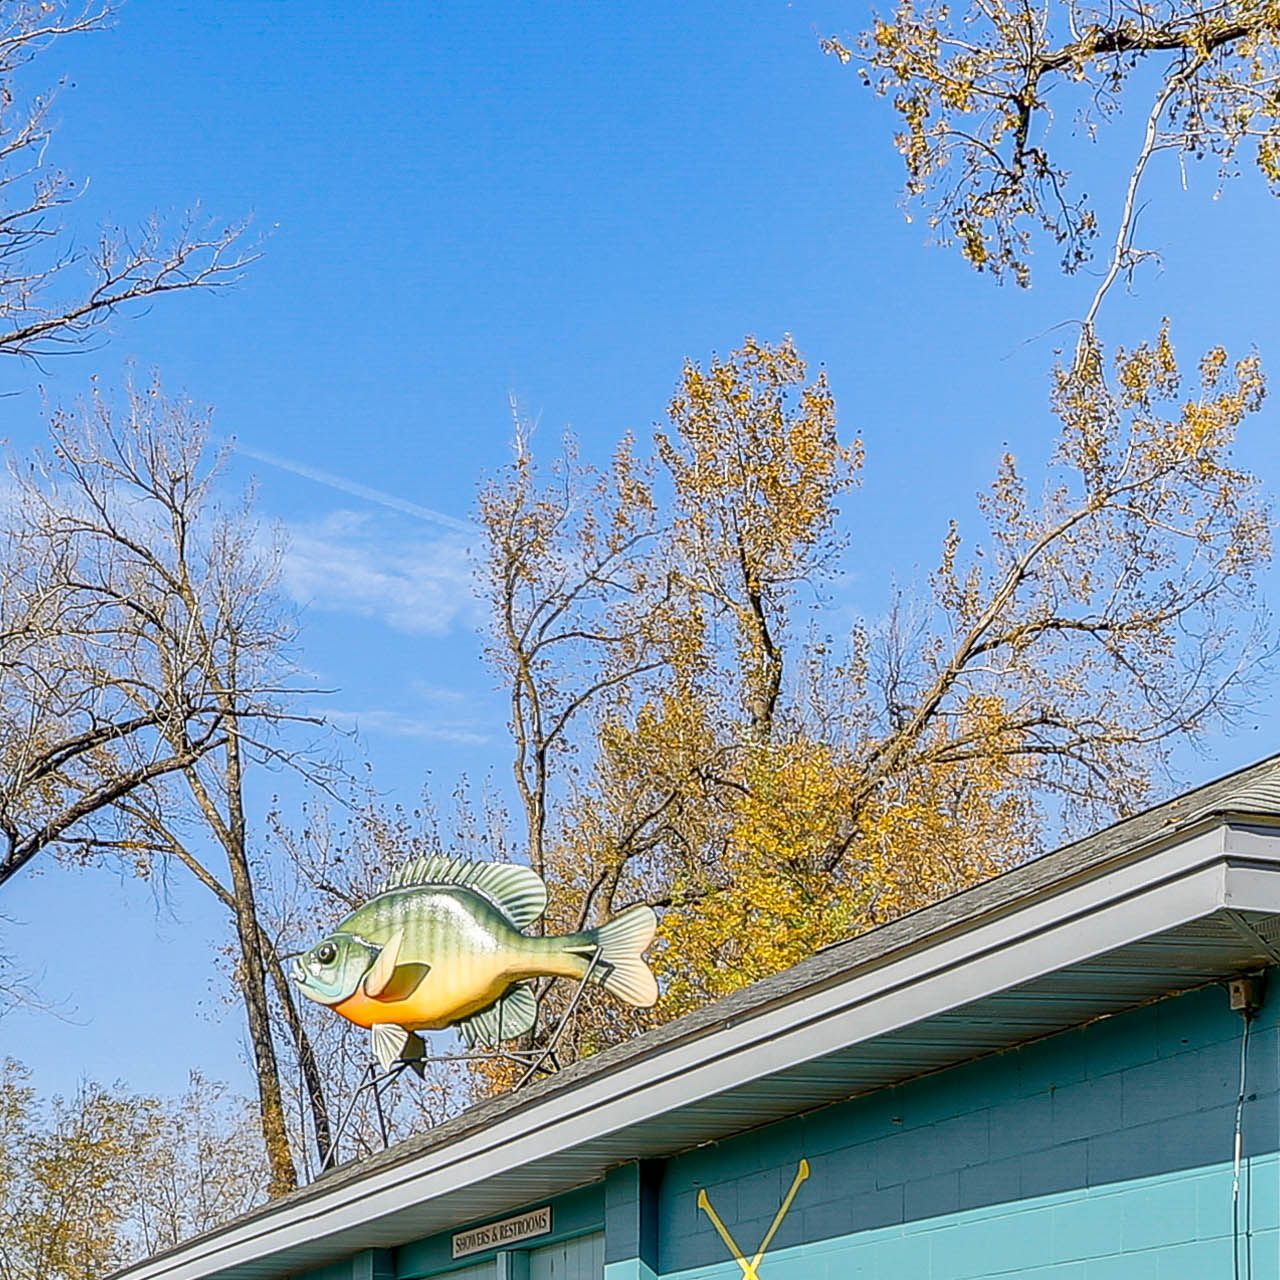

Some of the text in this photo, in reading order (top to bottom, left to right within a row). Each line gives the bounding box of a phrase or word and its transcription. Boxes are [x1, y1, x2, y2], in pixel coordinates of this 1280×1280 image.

[455, 1213, 547, 1253] SHOWERS & RESTROOMS
